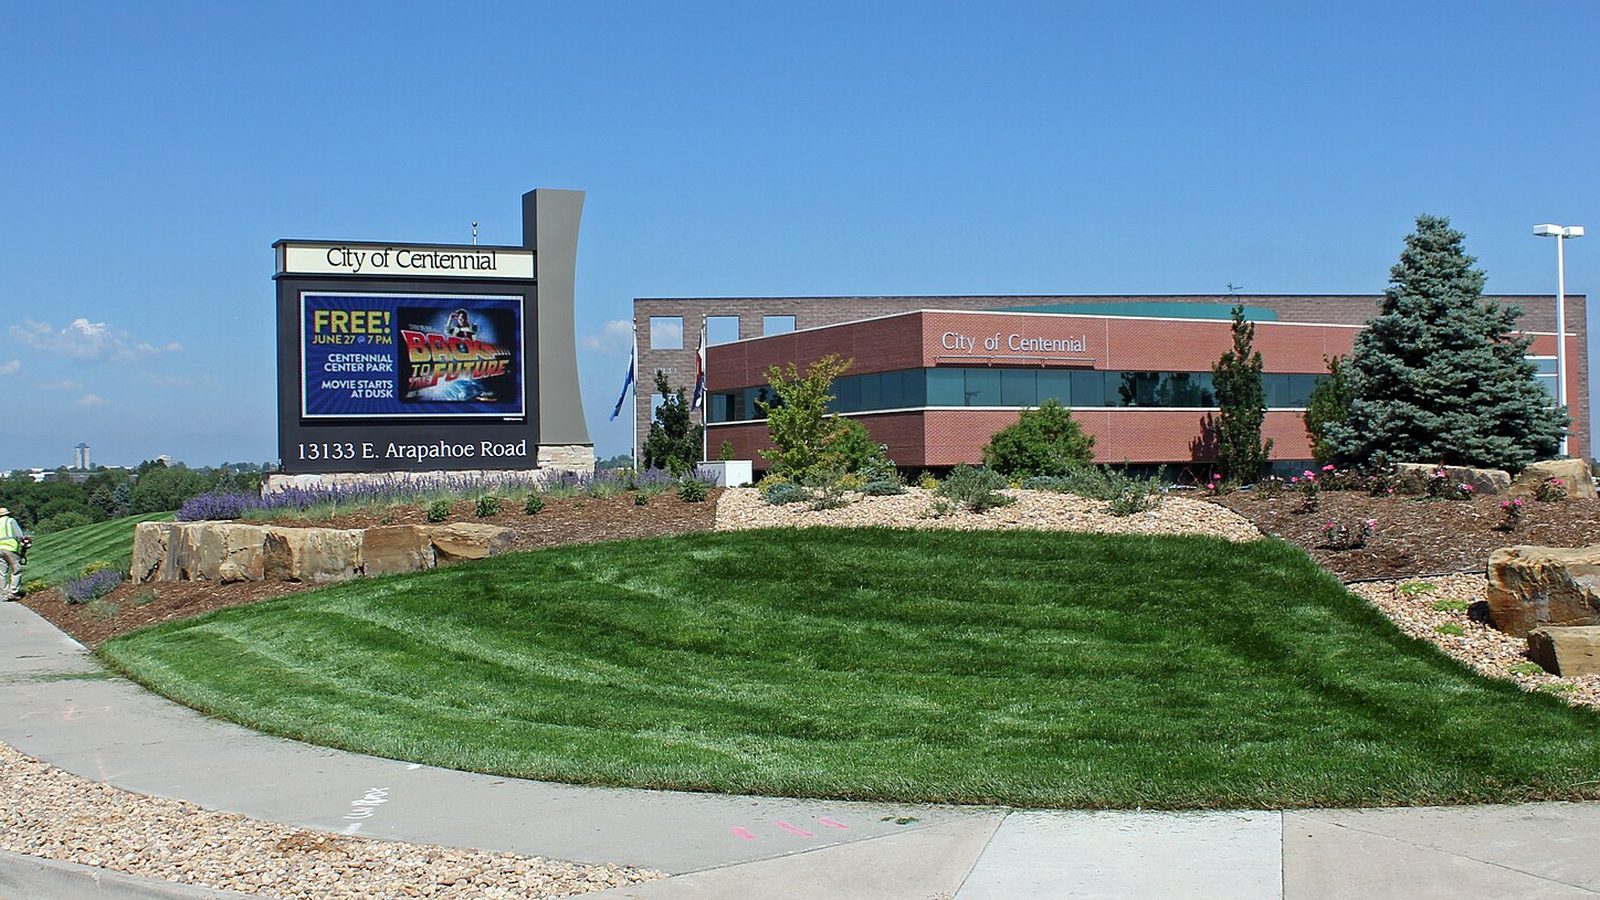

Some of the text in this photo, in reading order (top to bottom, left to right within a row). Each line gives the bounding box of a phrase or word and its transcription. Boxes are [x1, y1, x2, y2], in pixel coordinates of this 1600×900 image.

[327, 246, 497, 273] City of Centennial
[314, 310, 391, 334] FREE!
[312, 335, 343, 344] JUNE
[344, 335, 356, 345] 27
[367, 335, 374, 345] 7
[375, 335, 393, 345] PM
[401, 329, 501, 363] BACK
[942, 331, 1086, 353] City of Centennial
[324, 362, 393, 372] CENTER PARK
[328, 353, 393, 363] CENTENNIAL
[411, 364, 431, 377] TO
[430, 359, 510, 385] FUTURE
[321, 380, 393, 389] MOVIE STARTS
[351, 389, 394, 398] AT DUSK
[299, 439, 527, 463] 13133 E. Arapahoe Road
